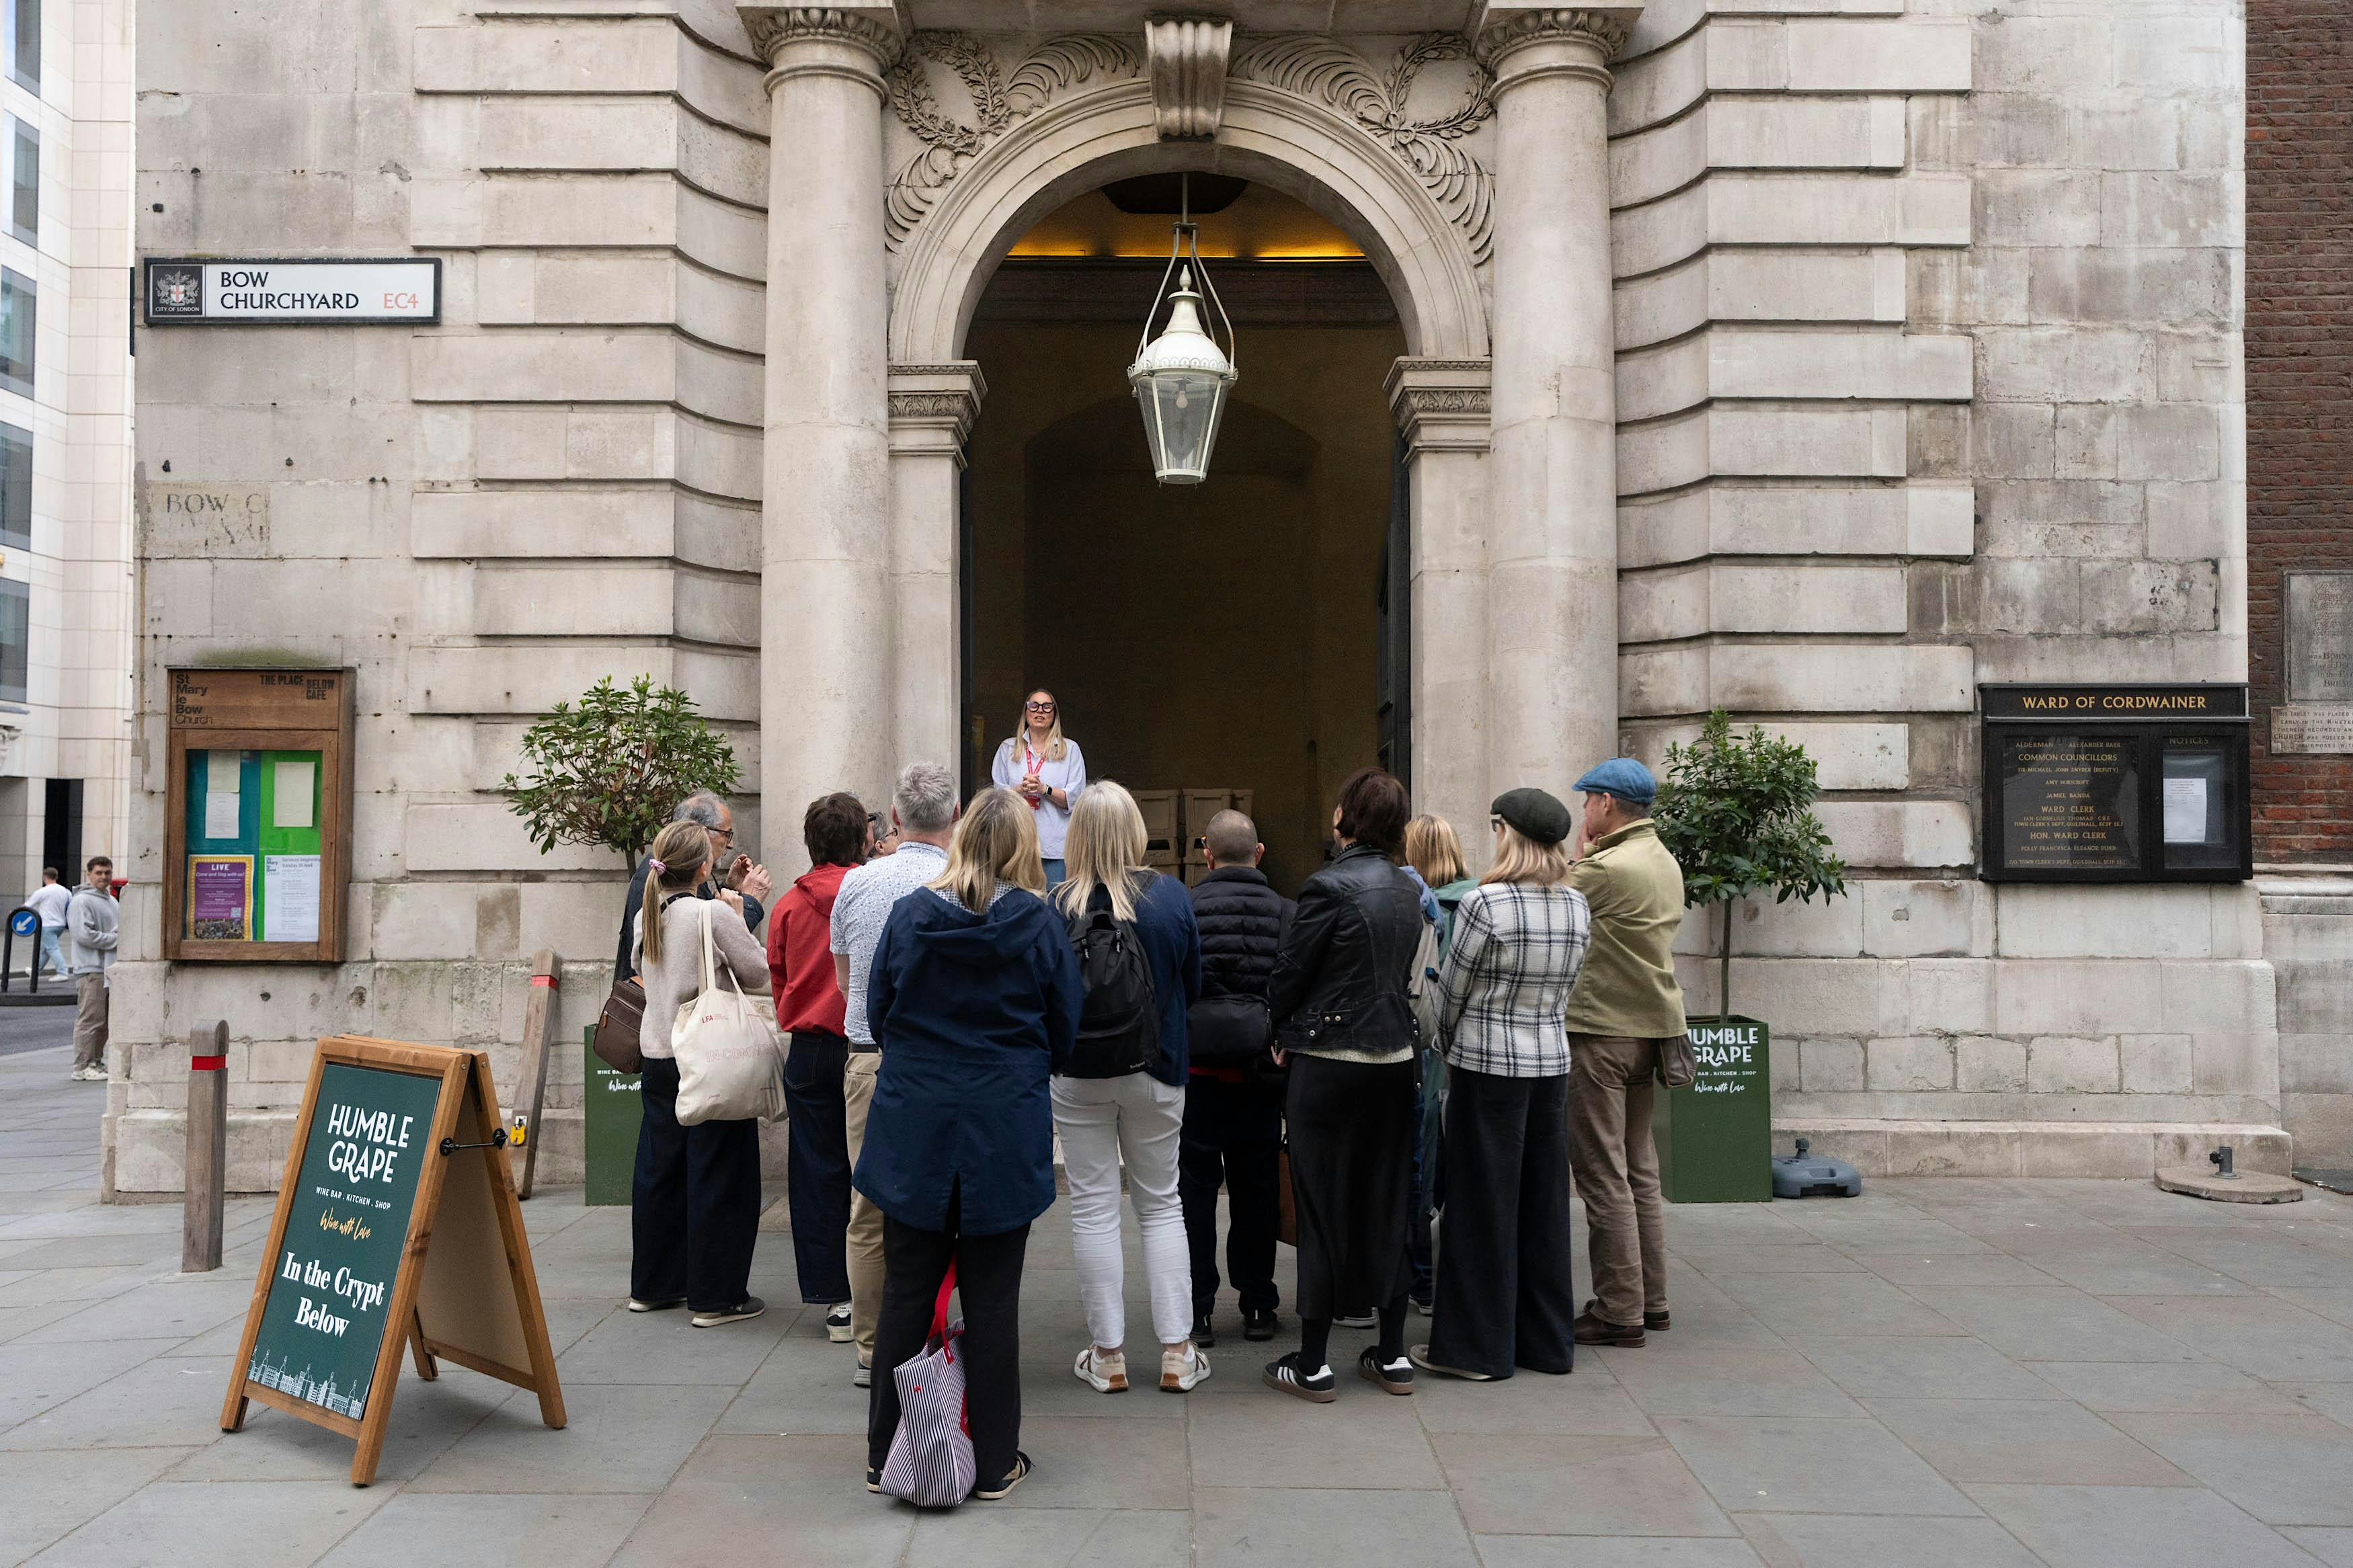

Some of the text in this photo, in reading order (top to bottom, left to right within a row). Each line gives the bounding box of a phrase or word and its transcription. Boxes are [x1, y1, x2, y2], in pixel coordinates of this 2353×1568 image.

[221, 272, 268, 287] BOW
[221, 293, 419, 309] CHURCHYARD EC4
[166, 493, 229, 513] BOW
[175, 674, 190, 684] St
[260, 675, 304, 685] THE PLACE
[306, 679, 335, 690] BELOW
[175, 684, 208, 696] Mary
[175, 694, 187, 704] le
[2022, 696, 2206, 708] WARD OF CORDWAINER
[175, 704, 202, 714] Bow
[175, 714, 213, 725] Church
[2169, 737, 2208, 745] NOTICES
[702, 1015, 713, 1024] LFA
[608, 1078, 627, 1091] Wine
[1694, 1081, 1745, 1094] Wine with Love
[327, 1104, 413, 1148] HUMBLE
[328, 1140, 398, 1184] GRAPE
[316, 1186, 391, 1210] WINE BAR KITCHEN SHOP
[320, 1207, 371, 1240] Wine with Love
[282, 1251, 385, 1311] In the Crypt
[294, 1296, 350, 1338] Below
